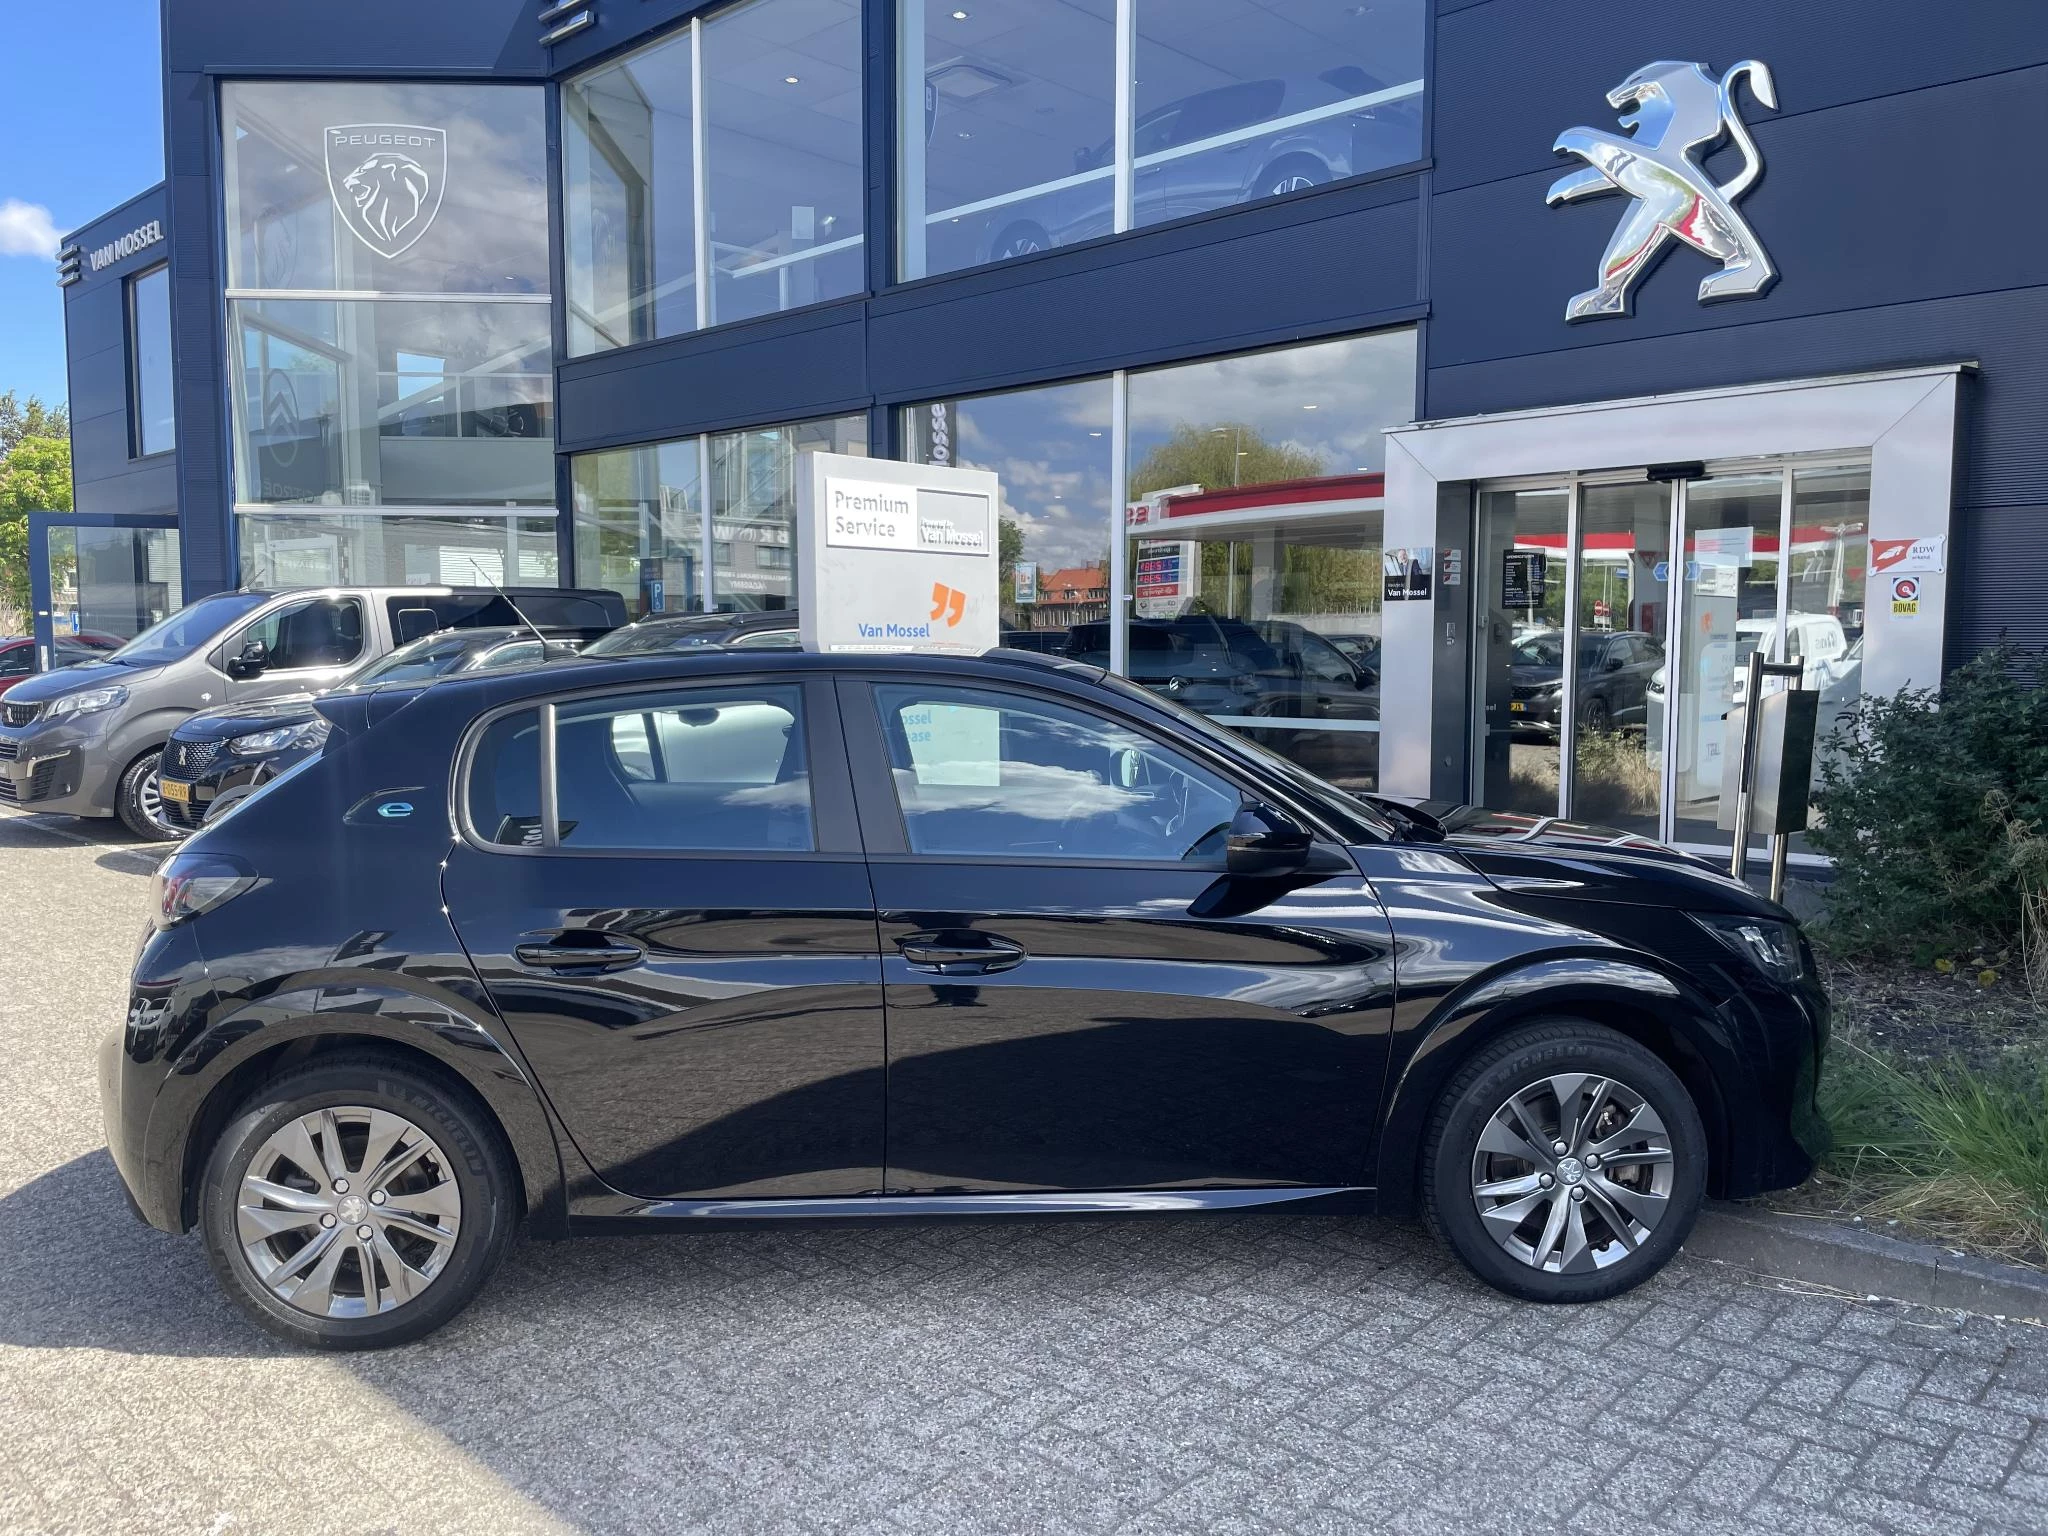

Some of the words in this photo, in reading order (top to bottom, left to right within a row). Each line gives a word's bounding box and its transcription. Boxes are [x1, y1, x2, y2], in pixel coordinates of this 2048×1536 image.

[335, 134, 436, 148] PEUGEOT
[90, 244, 114, 272] VAN
[114, 220, 164, 260] MOSSEL
[929, 403, 950, 467] osse
[835, 490, 909, 514] Premium
[835, 515, 896, 537] Service
[920, 528, 943, 544] Van
[944, 529, 984, 547] Mossel
[1912, 546, 1935, 554] RDW
[654, 584, 662, 598] P
[1387, 588, 1401, 597] Van
[1402, 587, 1427, 597] Mossel
[1893, 602, 1916, 613] BOVAG
[858, 623, 883, 637] Van
[886, 622, 931, 638] Mossel
[903, 708, 932, 726] ossel
